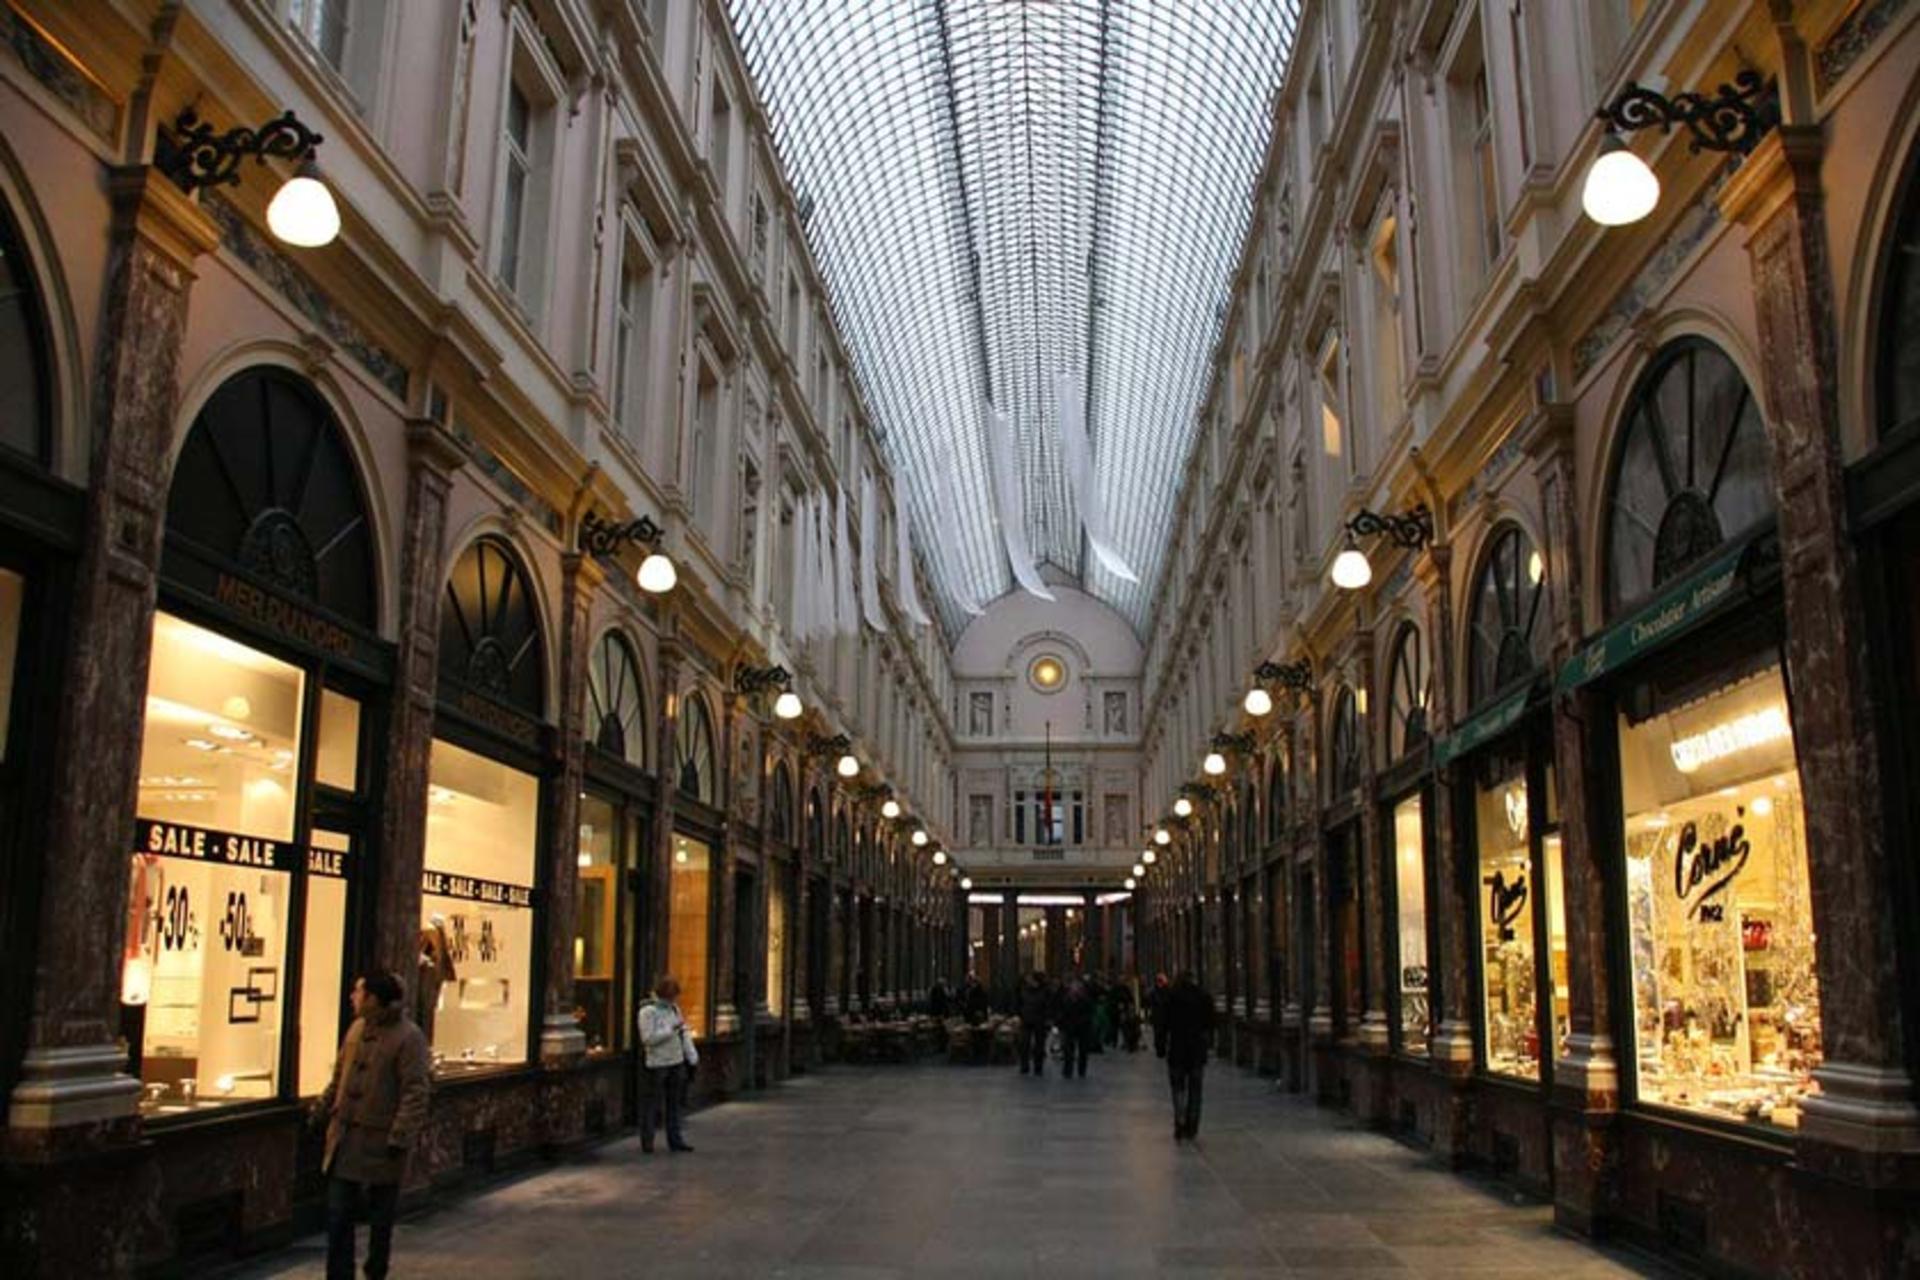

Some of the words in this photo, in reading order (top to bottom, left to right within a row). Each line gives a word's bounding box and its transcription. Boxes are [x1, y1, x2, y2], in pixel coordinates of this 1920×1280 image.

[150, 825, 205, 856] SALE
[226, 838, 275, 866] SALE
[449, 877, 475, 897] SALE
